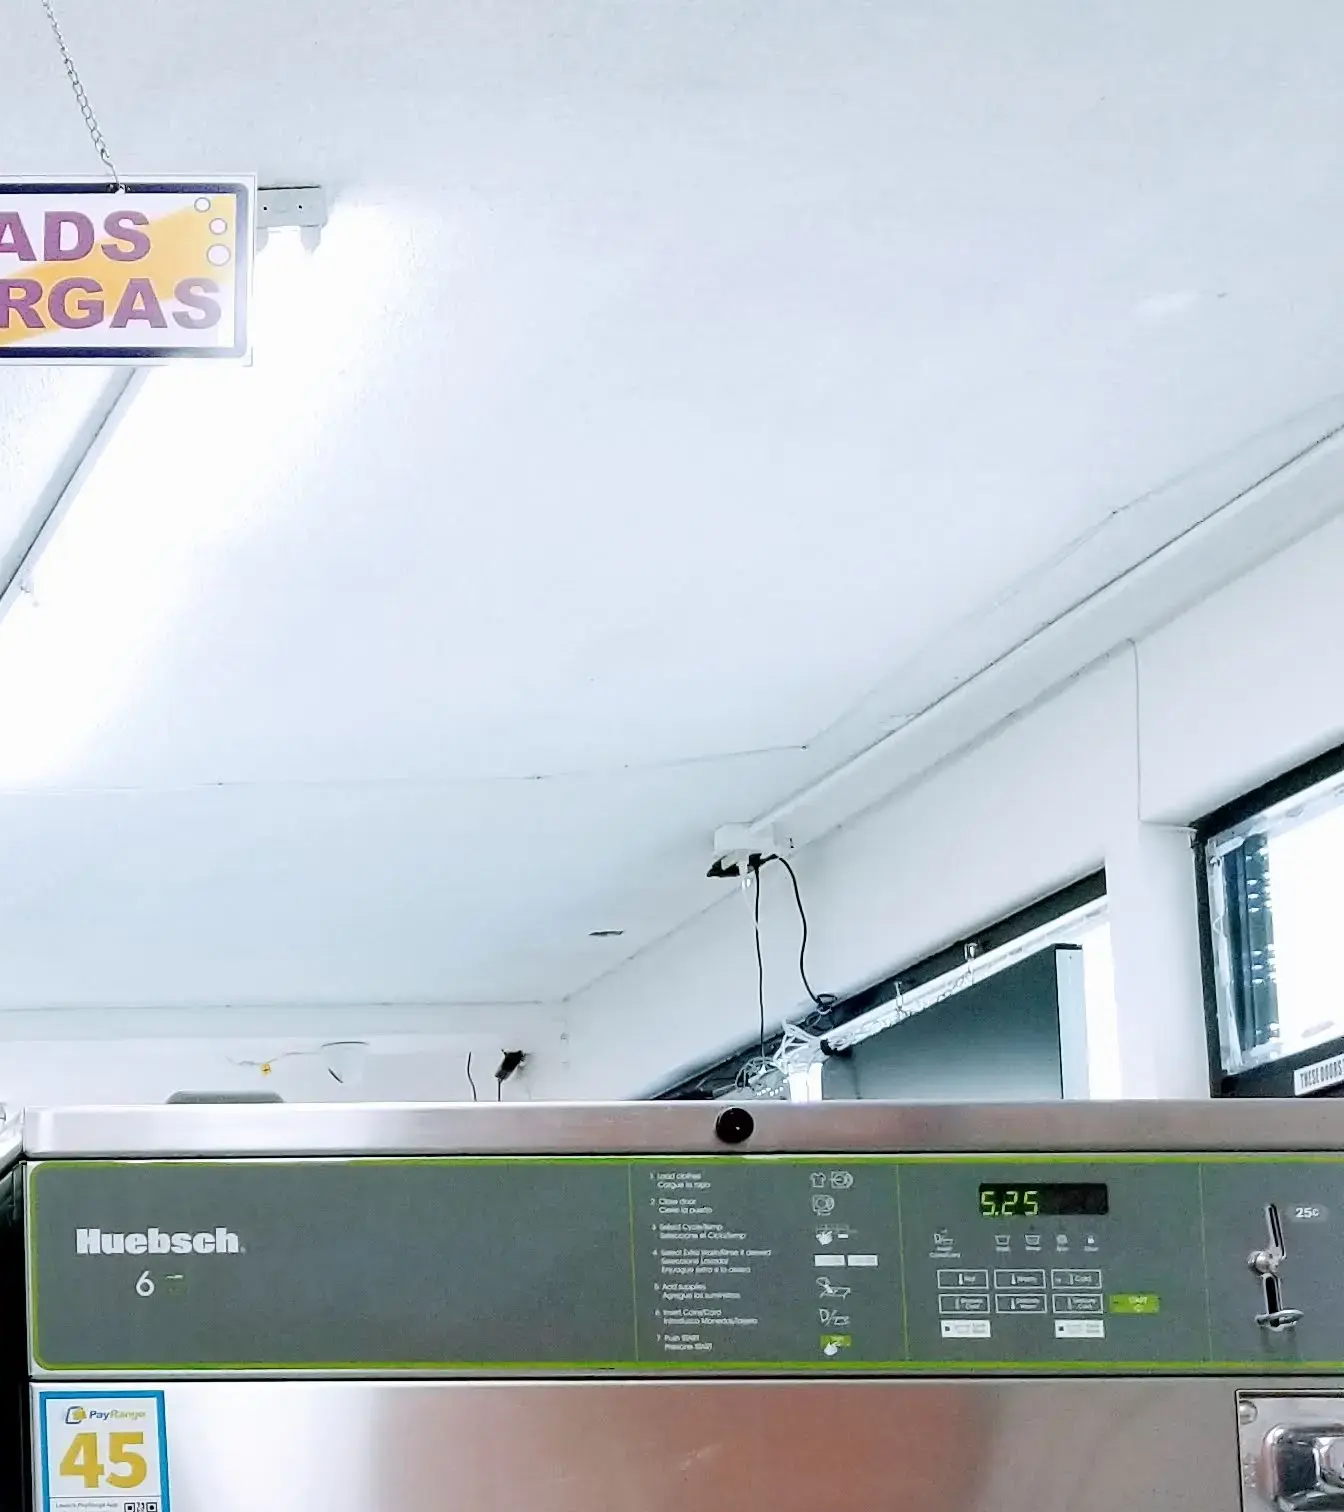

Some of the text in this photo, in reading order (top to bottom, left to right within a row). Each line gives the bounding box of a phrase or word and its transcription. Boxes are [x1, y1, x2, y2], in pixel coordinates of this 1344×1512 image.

[980, 1190, 1040, 1218] 5.25
[76, 1227, 240, 1254] Huebsch
[135, 1270, 155, 1297] 6
[88, 1409, 146, 1421] PayRange
[59, 1431, 148, 1489] 45
